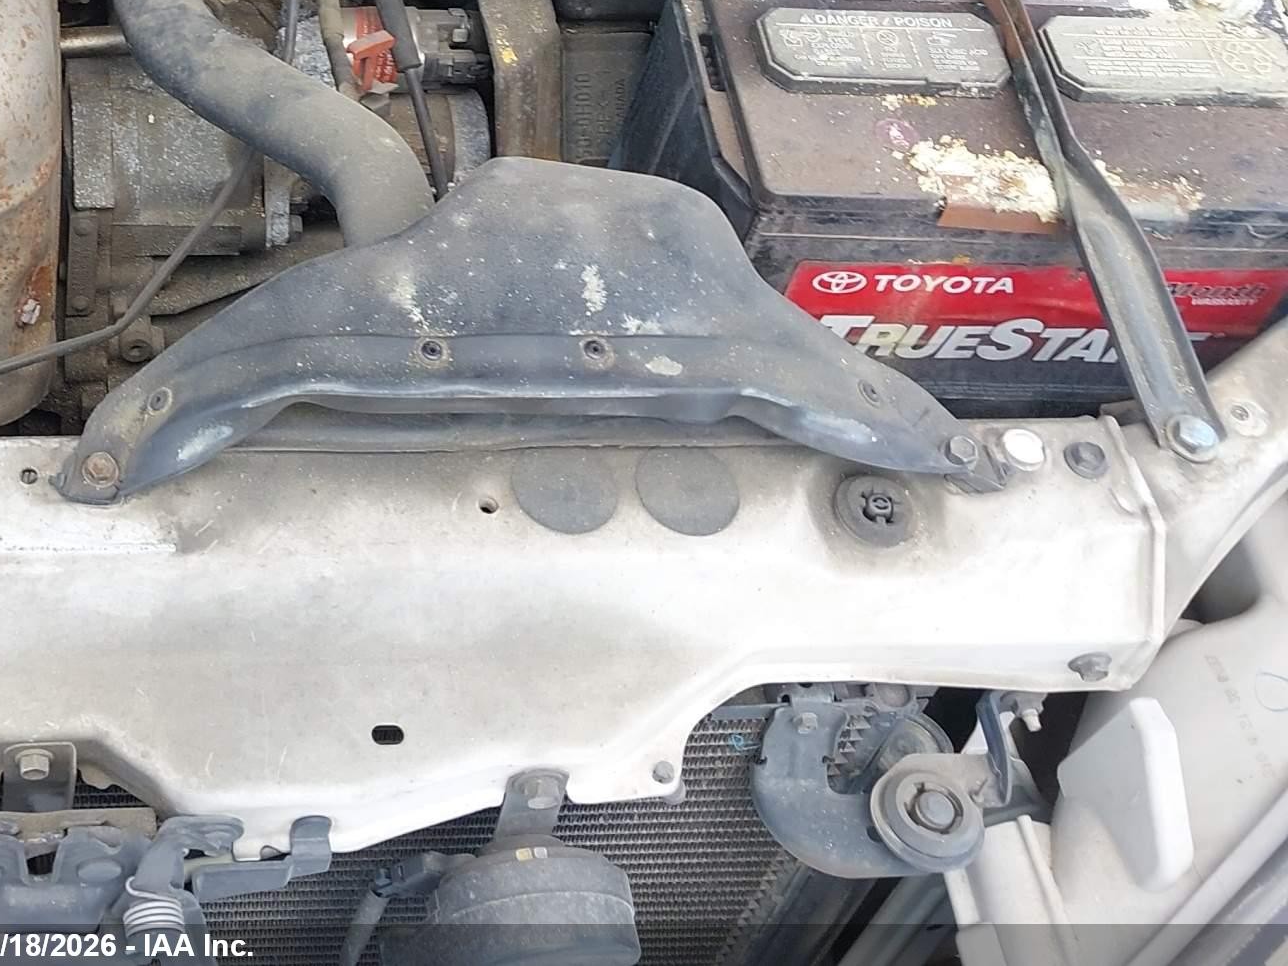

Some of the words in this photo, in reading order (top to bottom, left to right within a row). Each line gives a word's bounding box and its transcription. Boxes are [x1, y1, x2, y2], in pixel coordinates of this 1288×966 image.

[814, 14, 879, 26] DANGER
[894, 16, 953, 28] POISON
[874, 274, 1014, 294] TOYOTA
[820, 315, 1210, 362] TRUESTA
